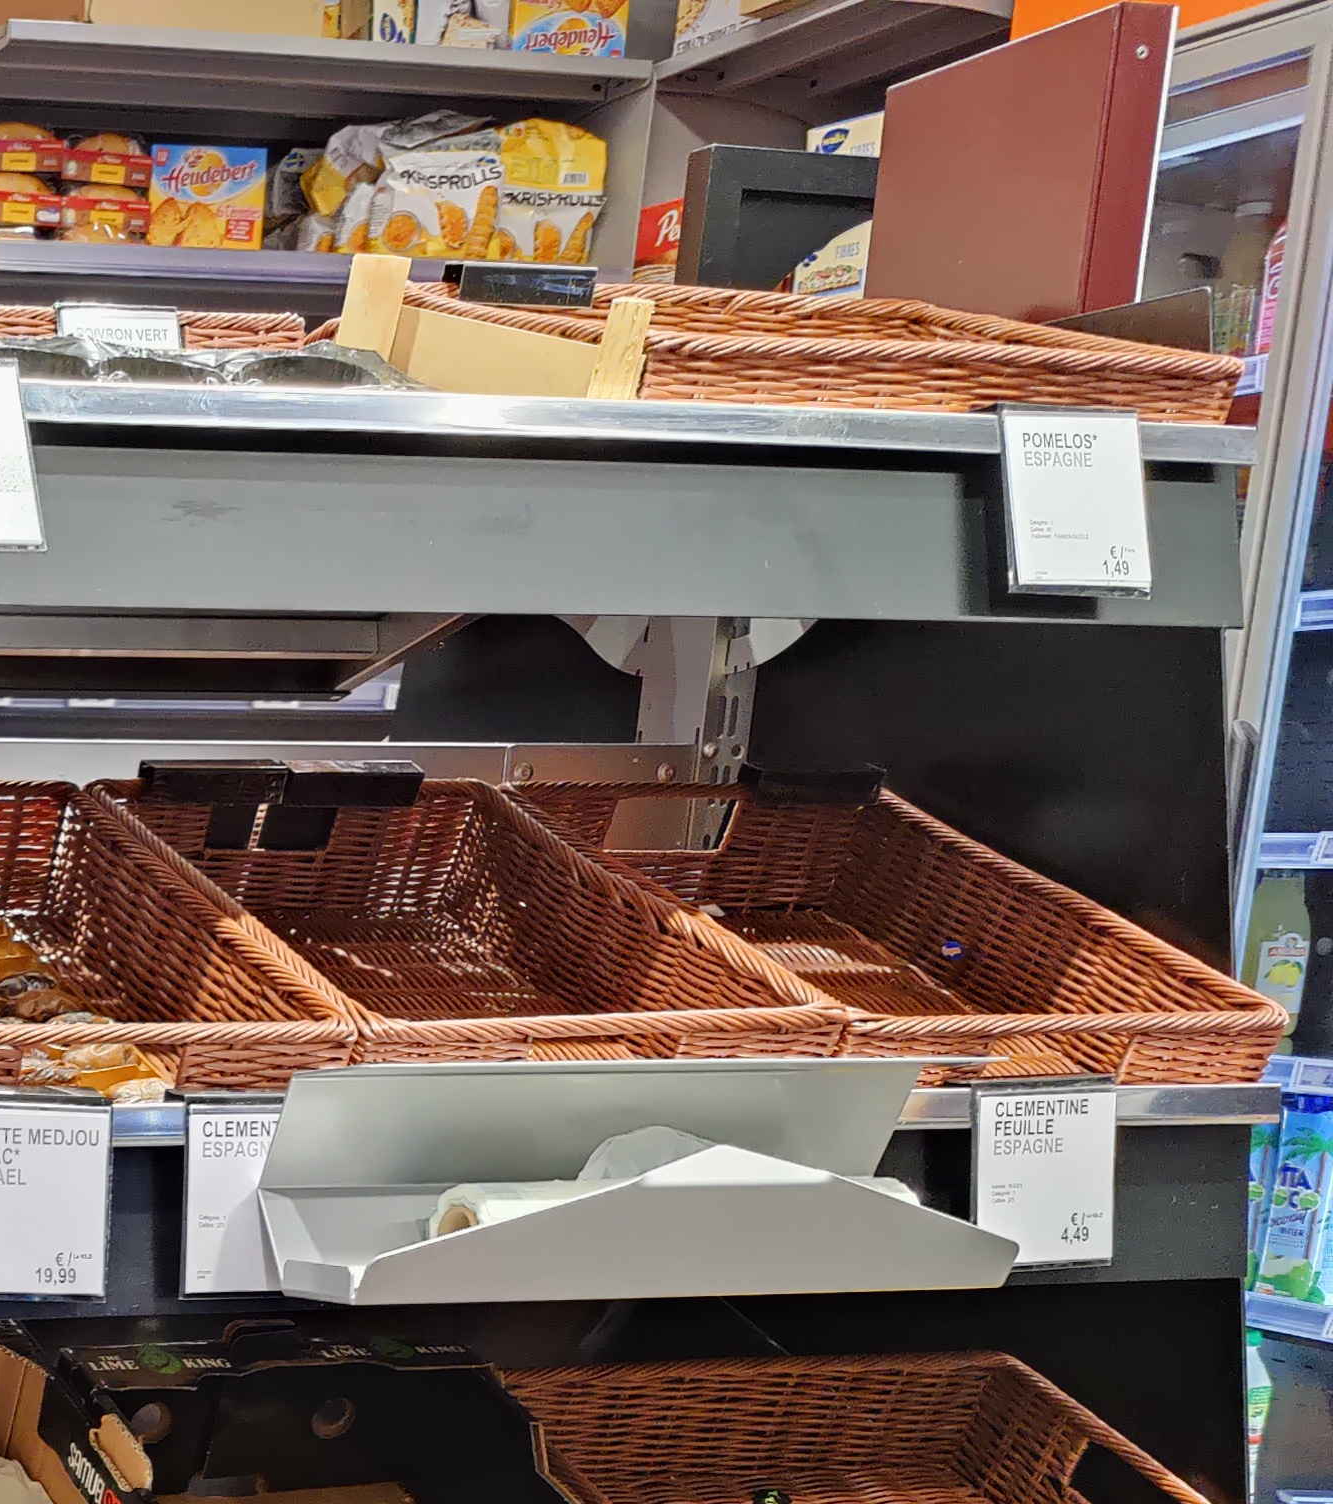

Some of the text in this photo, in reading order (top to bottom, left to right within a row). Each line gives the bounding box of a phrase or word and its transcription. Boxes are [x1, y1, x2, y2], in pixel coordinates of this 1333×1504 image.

[161, 160, 259, 193] Heudebert
[136, 329, 169, 342] VERT
[1024, 451, 1093, 468] ESPAGNE
[1102, 560, 1130, 577] 1,49
[995, 1099, 1090, 1118] CLEMENTINE
[994, 1119, 1054, 1137] FEUILLE
[28, 1128, 100, 1147] MEDJOU
[993, 1138, 1064, 1156] ESPAGNE
[1061, 1226, 1090, 1245] 4,49
[35, 1267, 76, 1287] 19,99
[88, 1356, 233, 1372] LIME KING
